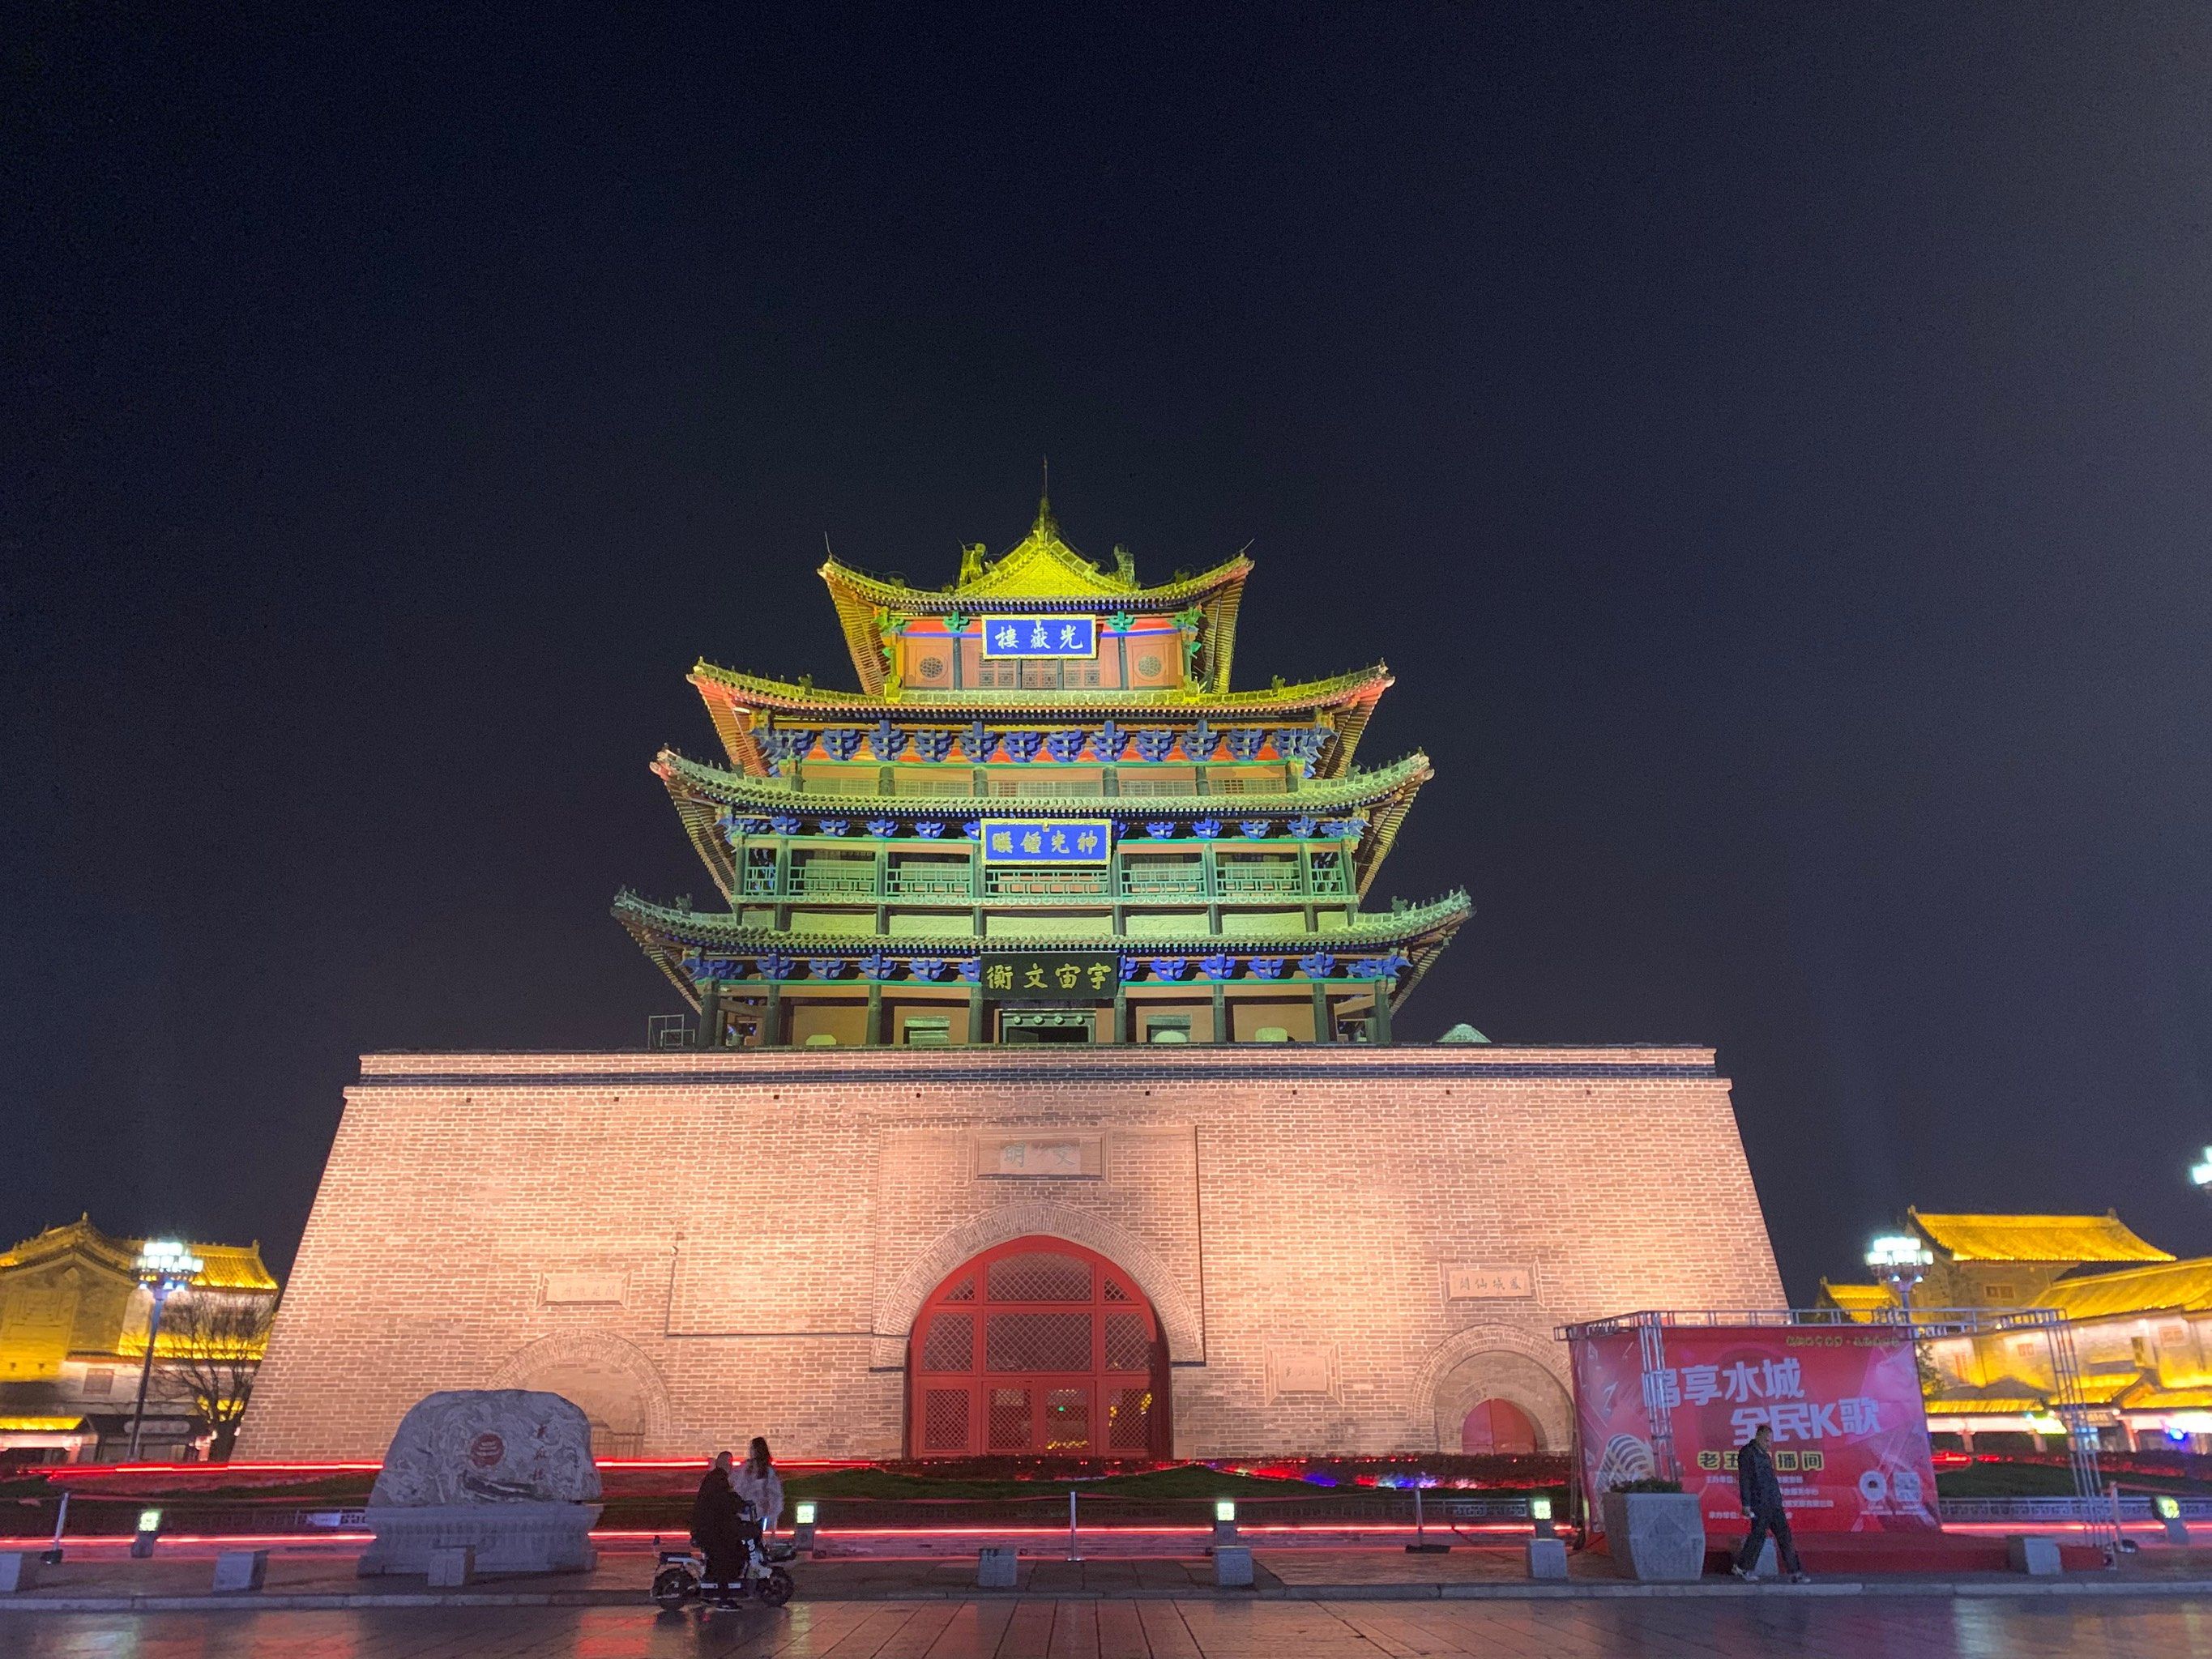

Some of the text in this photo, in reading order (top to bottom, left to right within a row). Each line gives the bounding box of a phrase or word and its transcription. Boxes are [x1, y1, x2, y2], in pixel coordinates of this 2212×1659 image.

[986, 962, 1112, 991] 宇宙文衡
[1730, 1397, 1881, 1446] 全民K歌
[1697, 1450, 1825, 1471] 老王播间
